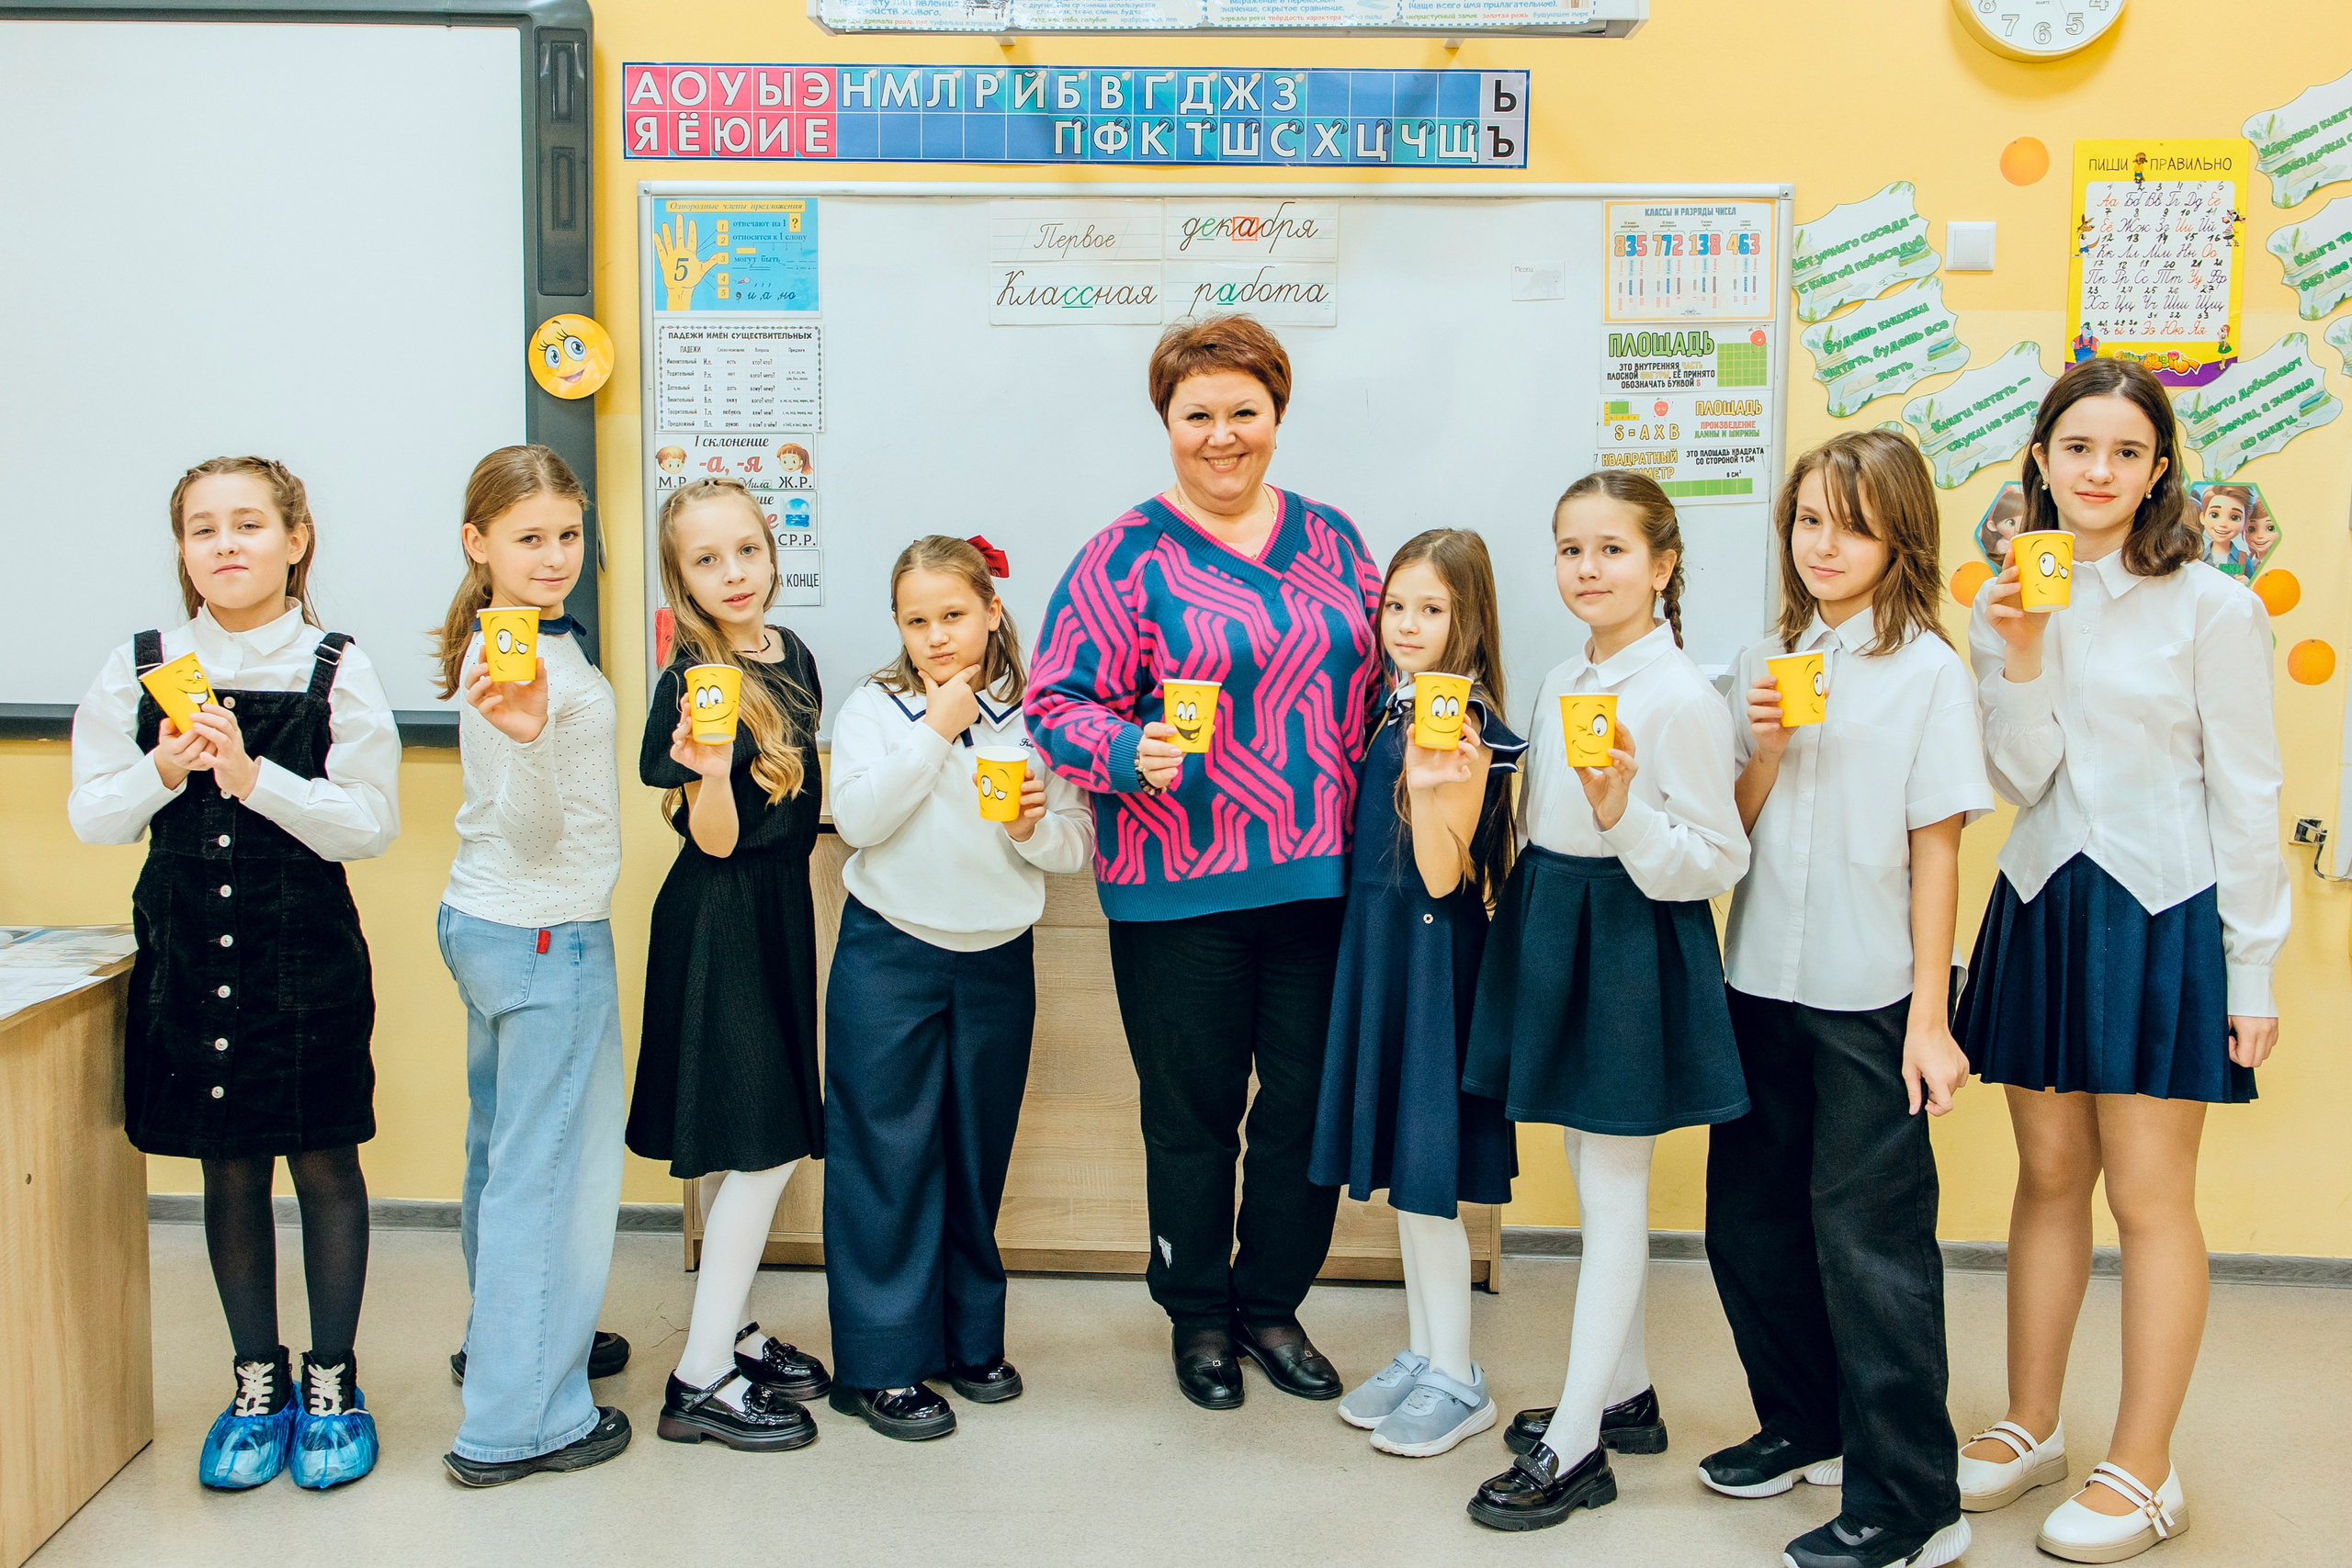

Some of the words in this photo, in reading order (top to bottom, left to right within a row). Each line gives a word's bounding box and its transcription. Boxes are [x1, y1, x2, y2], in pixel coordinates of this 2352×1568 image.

[1300, 5, 1345, 13] сравнение.
[2001, 14, 2020, 37] 7
[2032, 21, 2052, 45] 6
[2065, 12, 2085, 36] 5
[629, 72, 663, 106] А
[672, 71, 707, 107] О
[712, 72, 747, 106] У
[759, 73, 791, 107] Ы
[803, 72, 830, 107] Э
[842, 73, 873, 107] Н
[881, 73, 919, 107] М
[927, 73, 957, 108] Л
[976, 73, 999, 108] Р
[1014, 71, 1046, 109] Й
[1057, 74, 1081, 109] Б
[1102, 75, 1124, 109] В
[1145, 75, 1168, 109] Г
[1180, 75, 1214, 115] Д
[1222, 75, 1261, 111] Ж
[1272, 75, 1297, 111] З
[1495, 79, 1517, 113] Ь
[633, 117, 658, 152] Я
[679, 112, 700, 152] Ё
[715, 117, 752, 152] Ю
[760, 118, 789, 152] И
[807, 118, 829, 153] Е
[1055, 121, 1082, 155] П
[1093, 120, 1129, 155] Ф
[1142, 121, 1169, 155] К
[1185, 121, 1212, 155] Т
[1222, 121, 1259, 157] Ш
[1270, 121, 1297, 157] С
[1312, 123, 1344, 158] Х
[1357, 123, 1387, 162] Ц
[1400, 124, 1428, 159] Ч
[1438, 124, 1478, 163] Щ
[1487, 126, 1515, 159] Ъ
[2259, 124, 2319, 159] Хорошая
[2089, 158, 2129, 171] ПИШИ
[2150, 157, 2233, 171] ПРАВИЛЬНО
[2274, 137, 2347, 178] звездочки
[670, 202, 718, 210] Однородные
[1645, 208, 1672, 216] КЛАССЫ
[1674, 208, 1679, 216] И
[1680, 207, 1713, 217] РАЗРЯДЫ
[1715, 207, 1736, 216] ЧИСЕЛ
[1034, 222, 1116, 258] Первое
[1179, 201, 1319, 254] декабря
[1614, 235, 1647, 257] 835
[1653, 234, 1683, 256] 772
[1689, 234, 1721, 255] 138
[1726, 233, 1760, 255] 463
[1815, 239, 1860, 265] умного
[1860, 218, 1909, 243] соседа
[1798, 285, 1808, 294] с
[1809, 264, 1855, 290] книгой
[1854, 234, 1926, 272] побеседуй
[2294, 241, 2336, 267] Книга
[673, 257, 689, 282] 5
[997, 270, 1158, 308] Классная
[1187, 265, 1329, 317] работа
[2300, 272, 2324, 291] без
[1877, 302, 1929, 332] книжки
[669, 332, 704, 340] ПАДЕЖИ
[707, 331, 729, 340] ИМЁН
[731, 332, 812, 341] СУЩЕСТВИТЕЛЬНЫХ
[1609, 331, 1714, 357] ПЛОЩАДЬ
[680, 345, 701, 354] ПАДЕЖИ
[1823, 355, 1873, 378] читать,
[1872, 332, 1924, 358] будешь
[1924, 320, 1950, 337] все
[1607, 369, 1638, 380] ПЛОСКОЙ
[1673, 369, 1682, 378] ЕЁ
[1683, 369, 1715, 378] ПРИНЯТО
[1619, 363, 1633, 371] ЭТО
[1634, 362, 1679, 371] ВНУТРЕННЯЯ
[1876, 361, 1914, 383] знать
[1621, 379, 1666, 389] ОБОЗНАЧАТЬ
[1668, 378, 1694, 388] БУКВОЙ
[2188, 395, 2236, 425] Золото
[2238, 356, 2303, 401] добывают
[1695, 400, 1763, 417] ПЛОЩАДЬ
[1931, 407, 1973, 434] Книги
[1973, 386, 2018, 412] читать
[2199, 431, 2220, 446] из
[2220, 408, 2262, 437] земли,
[2260, 402, 2271, 412] а
[2269, 378, 2314, 408] знания
[1694, 430, 1719, 439] ДЛИНЫ
[1722, 430, 1727, 438] И
[1728, 429, 1760, 438] ШИРИНЫ
[1701, 420, 1756, 430] ПРОИЗВЕДЕНИЕ
[1947, 426, 1987, 452] скуки
[1985, 418, 2003, 433] не
[2002, 400, 2039, 423] знать
[703, 435, 770, 447] склонение
[1686, 449, 1698, 457] ЭТО
[1700, 448, 1730, 457] ПЛОЩАДЬ
[1732, 447, 1765, 457] КВАДРАТА
[2240, 435, 2256, 450] из
[1601, 448, 1678, 468] КВАДРАТНЫЙ
[1705, 455, 1738, 464] СТОРОНОЙ
[778, 476, 812, 489] Ж.Р.
[778, 534, 816, 546] СР.Р.
[786, 574, 820, 588] КОНЦЕ
